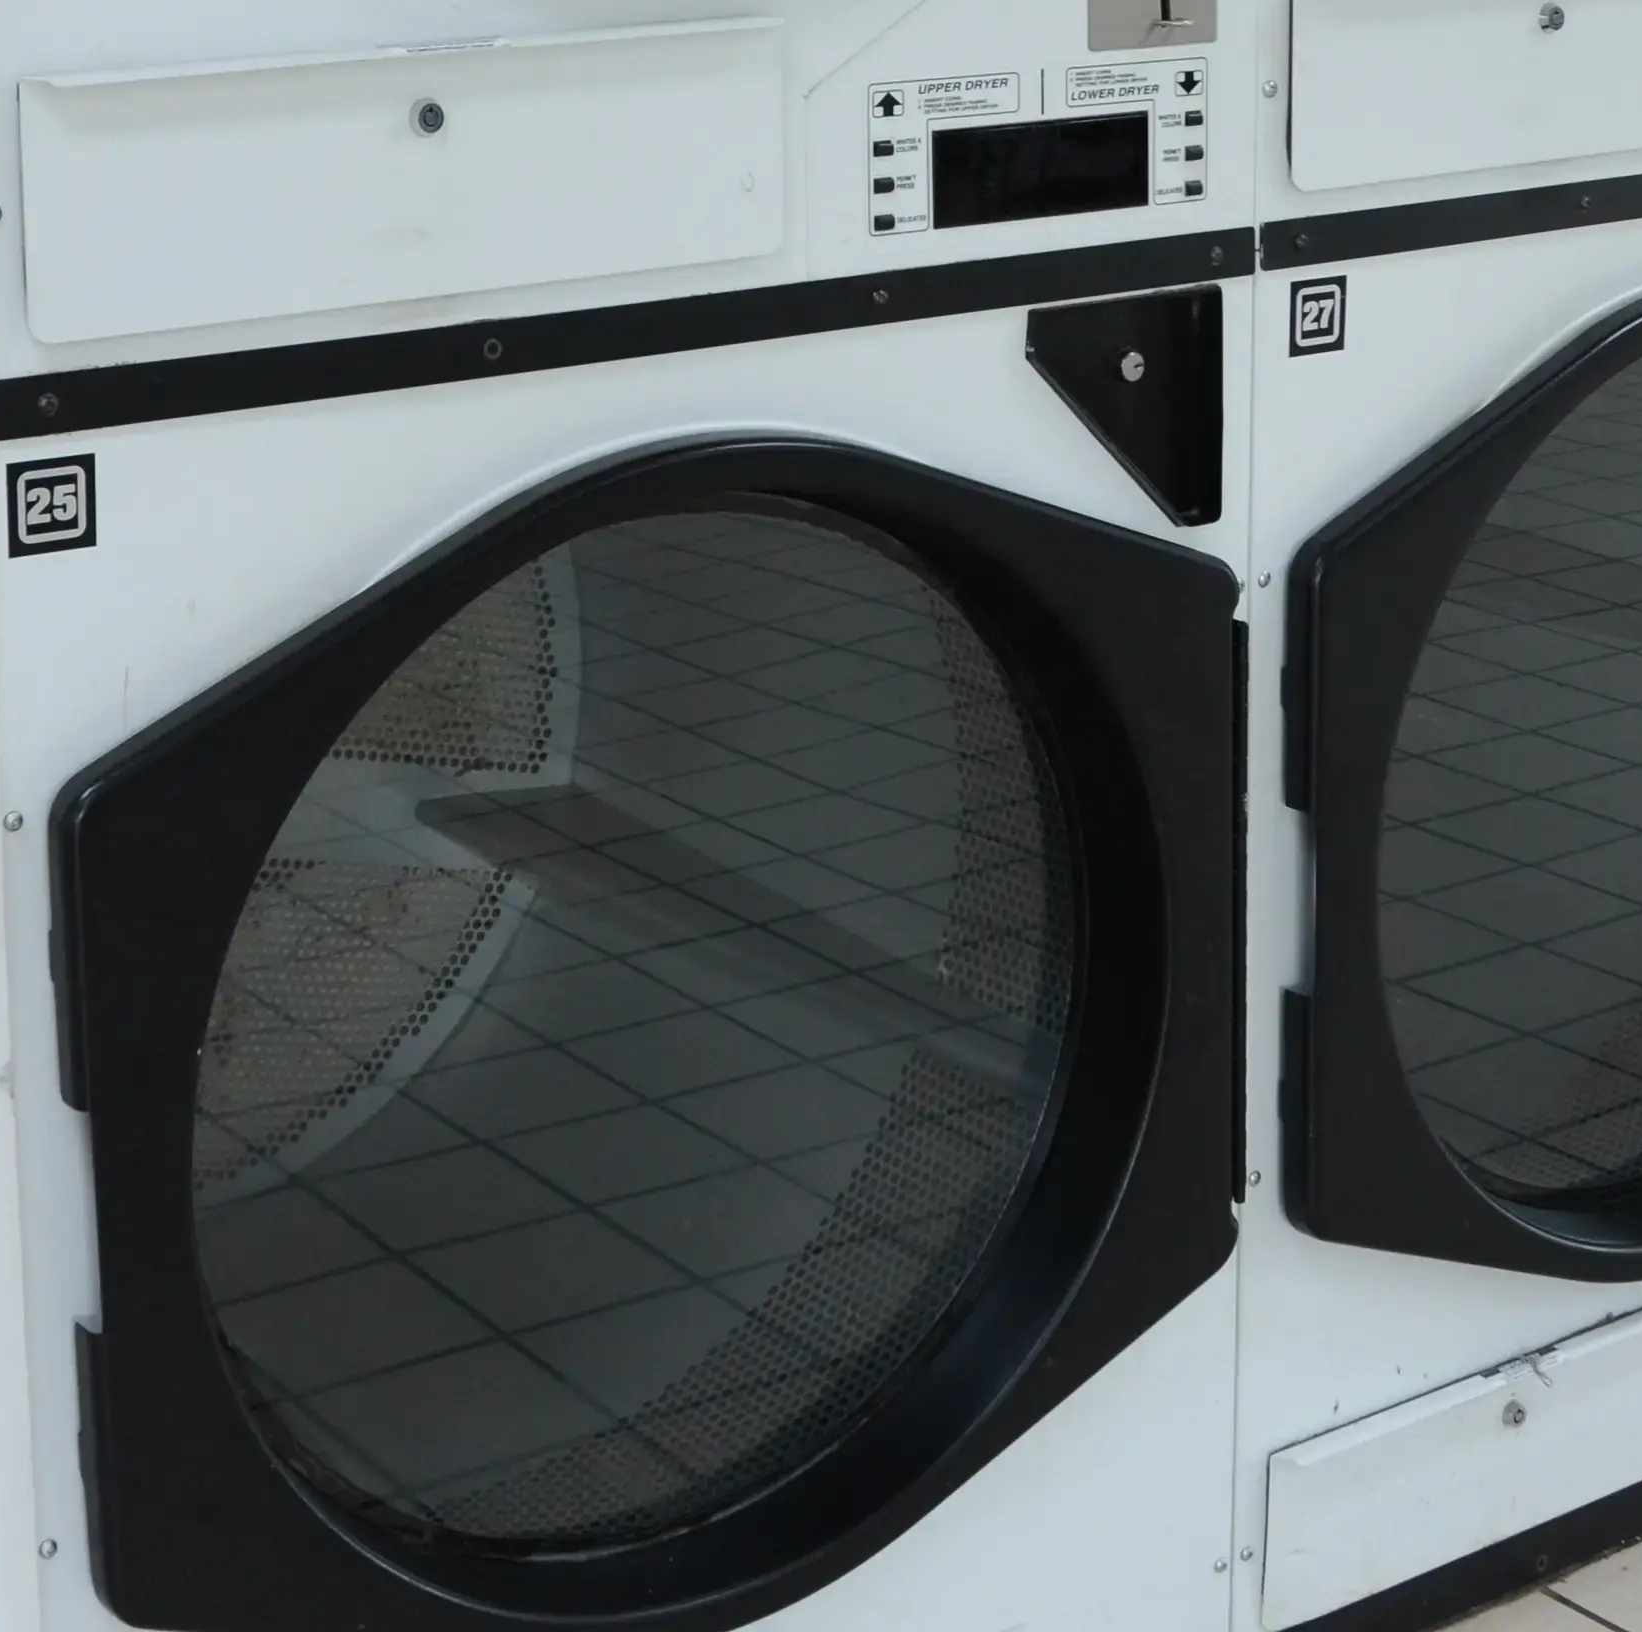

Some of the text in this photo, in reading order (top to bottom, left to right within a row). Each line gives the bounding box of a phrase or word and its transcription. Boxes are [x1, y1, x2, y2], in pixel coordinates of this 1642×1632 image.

[918, 77, 1009, 95] UPPER DRYER
[1071, 84, 1160, 101] LOWER DRYER
[1302, 299, 1334, 332] 27
[26, 483, 77, 526] 25
